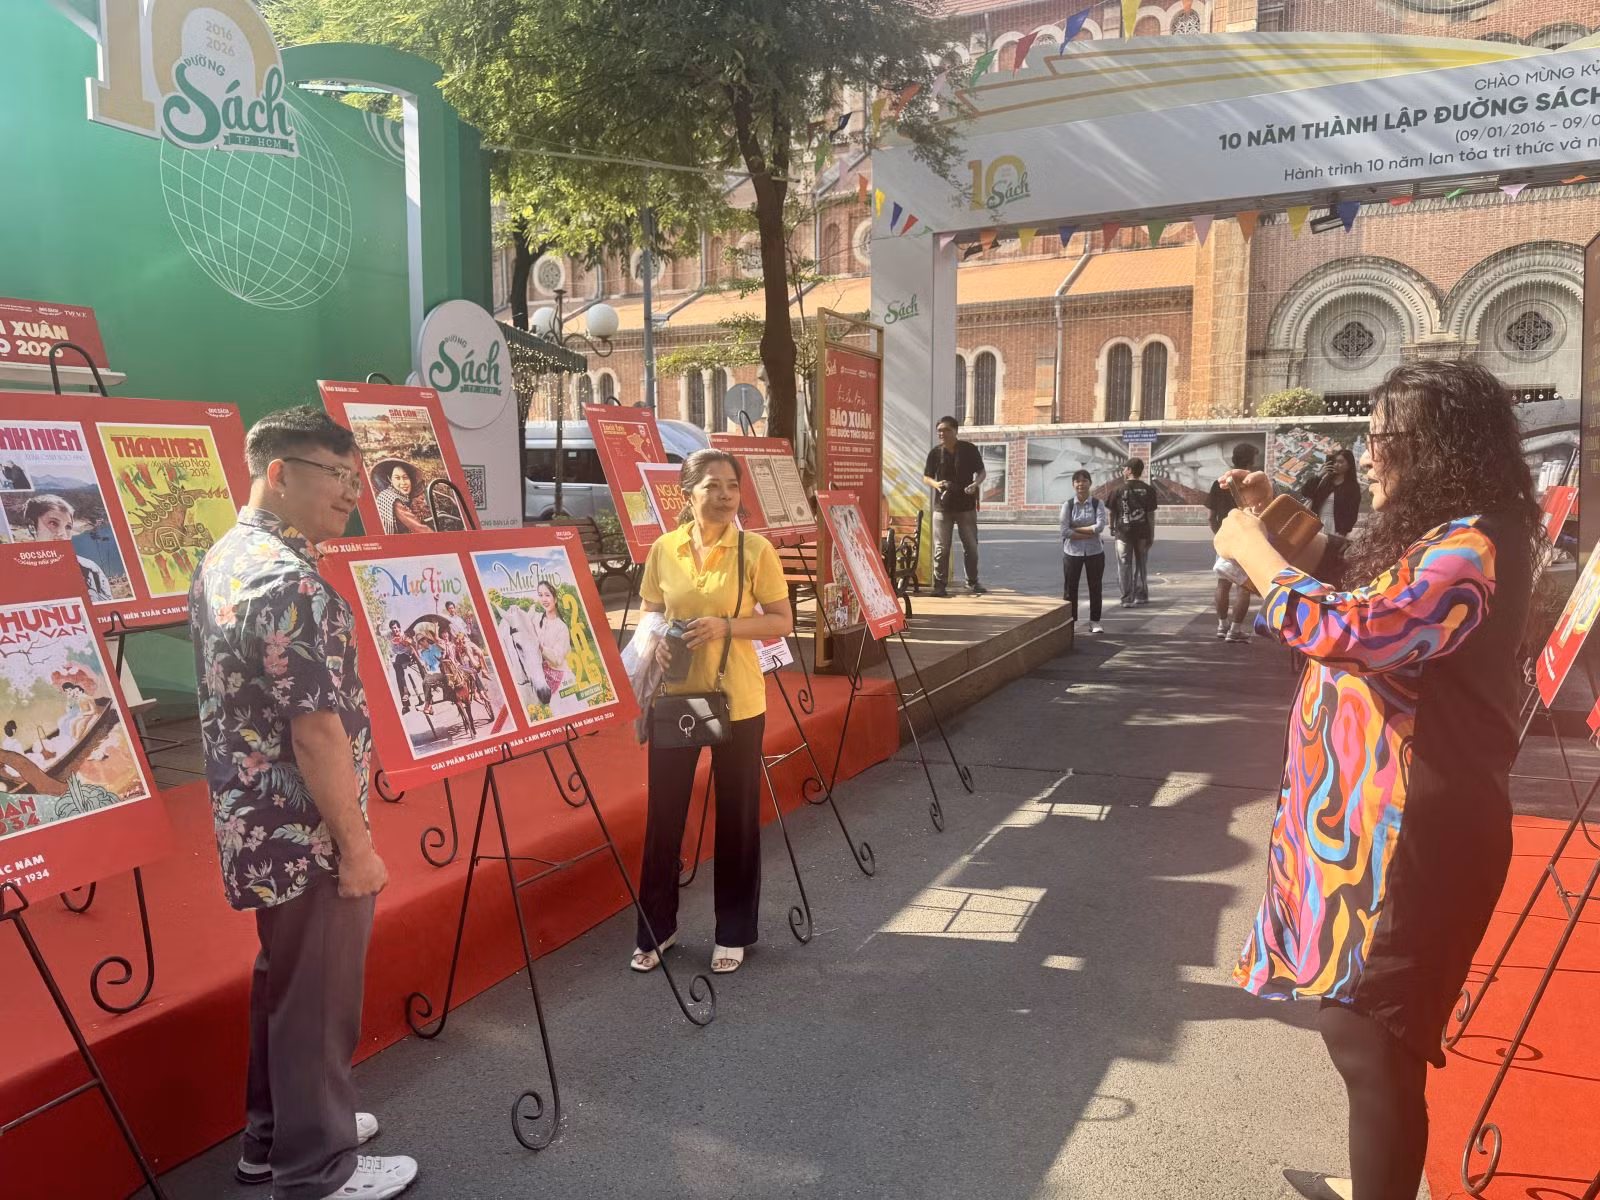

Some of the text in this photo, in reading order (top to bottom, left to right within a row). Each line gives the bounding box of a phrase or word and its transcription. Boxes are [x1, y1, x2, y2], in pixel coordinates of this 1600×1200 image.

[205, 20, 233, 41] 2016
[206, 37, 235, 57] 2026
[1475, 72, 1520, 91] CHÀO
[1526, 66, 1575, 84] MỪNG
[162, 66, 293, 145] Sách
[1219, 132, 1242, 150] 10
[1247, 124, 1296, 147] NĂM
[1302, 115, 1378, 140] THÀNH
[1384, 106, 1428, 133] LẬP
[1434, 96, 1528, 124] ĐƯỜNG
[1455, 120, 1545, 143] (09/01/2016
[258, 137, 281, 149] HCM
[1284, 166, 1323, 181] Hành
[1328, 162, 1362, 177] trình
[1367, 159, 1384, 172] 10
[1389, 156, 1424, 170] năm
[1429, 153, 1454, 166] lan
[1459, 147, 1488, 162] tỏa
[1493, 144, 1511, 158] tri
[1515, 140, 1555, 156] thức
[1560, 136, 1581, 151] và
[986, 171, 1031, 210] Sách
[884, 293, 919, 324] Sách
[10, 320, 70, 340] XUÂN
[429, 340, 502, 393] Sách
[830, 407, 872, 430] BÁO XUÂN
[140, 609, 161, 618] XUÂN
[162, 607, 181, 615] CANH
[466, 750, 484, 760] XUÂN
[25, 868, 50, 883] 1934
